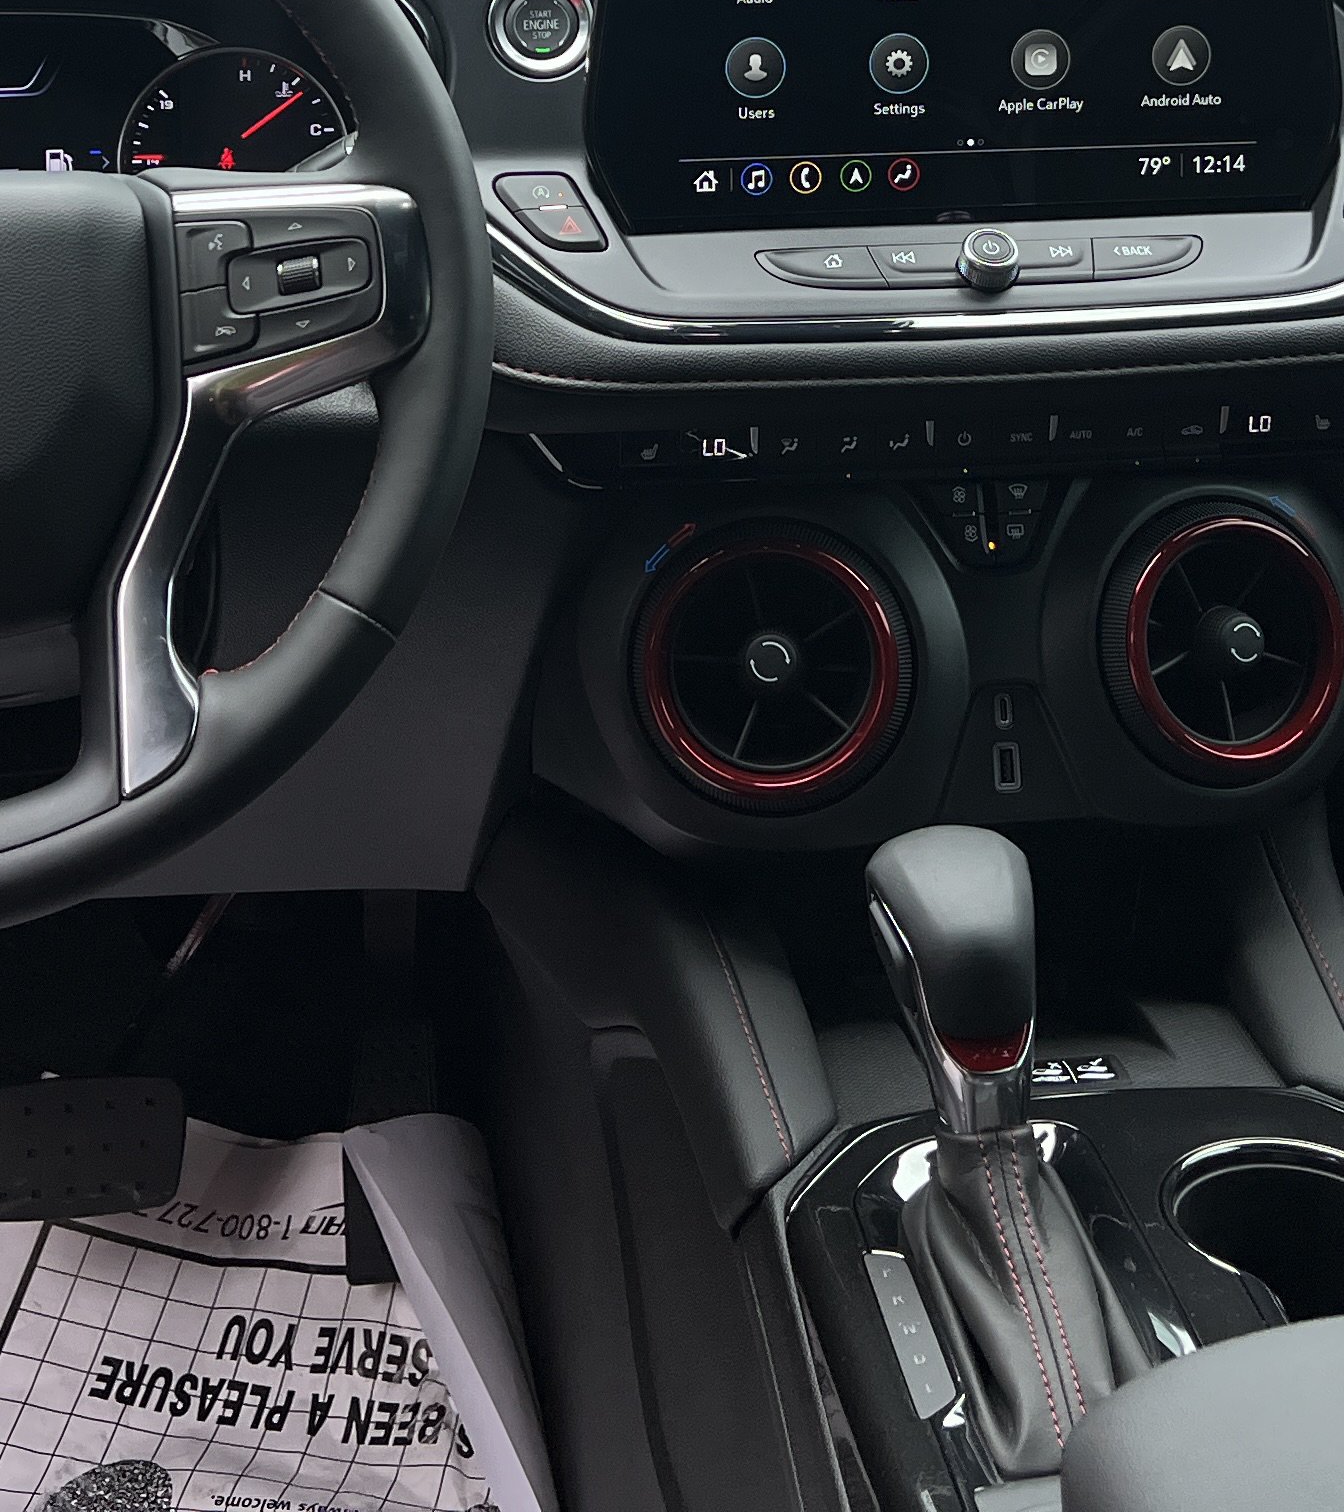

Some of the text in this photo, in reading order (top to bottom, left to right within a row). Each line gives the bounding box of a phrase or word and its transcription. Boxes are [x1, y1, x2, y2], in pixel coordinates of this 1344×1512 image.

[529, 10, 552, 19] START
[523, 18, 560, 31] ENGINE
[532, 31, 552, 39] STOP
[239, 69, 252, 81] H
[159, 99, 174, 110] 19
[998, 96, 1084, 115] Apple CarPlay
[1140, 94, 1222, 108] Android Auto
[738, 106, 775, 120] Users
[873, 101, 926, 118] Settings
[309, 123, 322, 136] C
[1138, 156, 1171, 175] 79°
[1192, 154, 1246, 174] 12:14
[1122, 245, 1153, 256] BACK
[1248, 414, 1272, 432] LO
[1010, 431, 1033, 443] SYNC
[1069, 430, 1093, 440] AUTO
[1126, 427, 1144, 438] A/C
[703, 438, 726, 456] LO
[216, 1314, 435, 1388] SERVE YOU
[87, 1354, 296, 1433] PLEASURE
[306, 1392, 336, 1436] A
[340, 1392, 448, 1446] BEEN
[210, 1493, 292, 1512] welcome.
